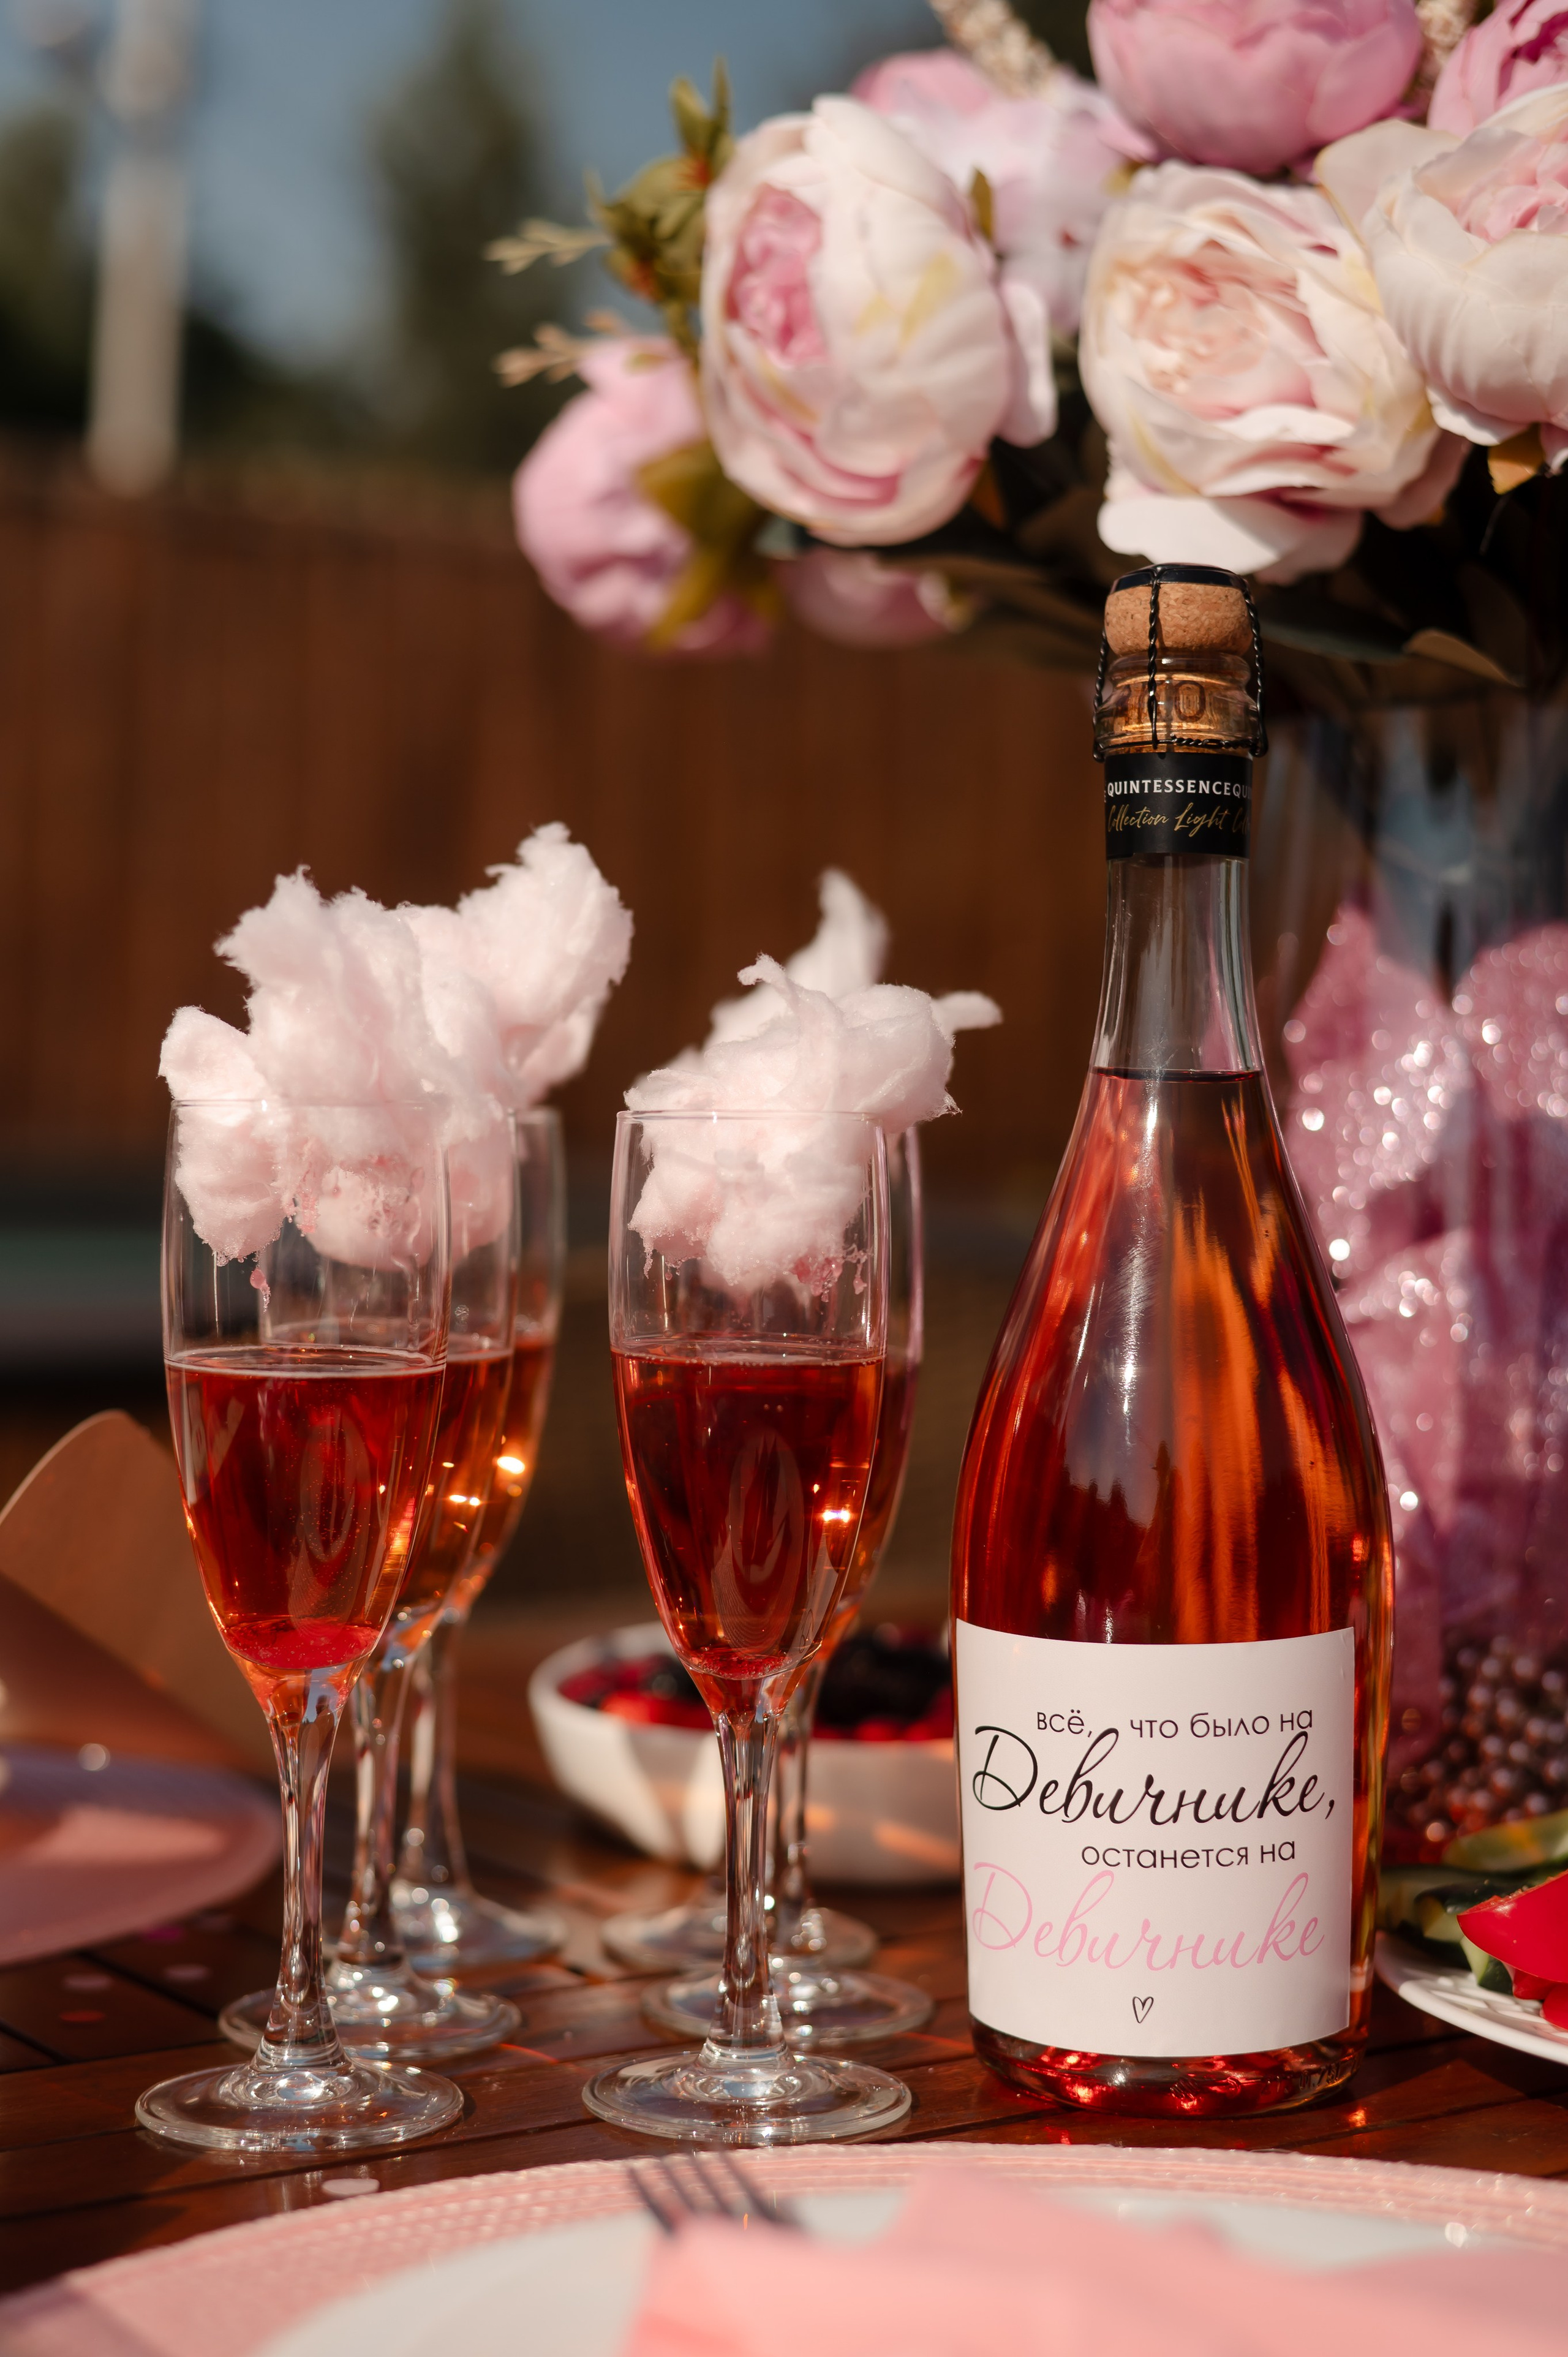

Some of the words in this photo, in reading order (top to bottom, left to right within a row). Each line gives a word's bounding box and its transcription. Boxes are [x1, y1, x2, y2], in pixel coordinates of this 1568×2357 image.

[1107, 804, 1169, 832] Collection
[1174, 802, 1231, 837] Light
[1036, 1708, 1093, 1738] всё,
[1129, 1719, 1179, 1739] что
[1189, 1712, 1270, 1738] было
[1280, 1709, 1313, 1733] на
[972, 1725, 1335, 1826] Девичнике,
[1081, 1846, 1250, 1869] останется
[1260, 1840, 1295, 1864] на
[972, 1861, 1325, 1971] Девичнике
